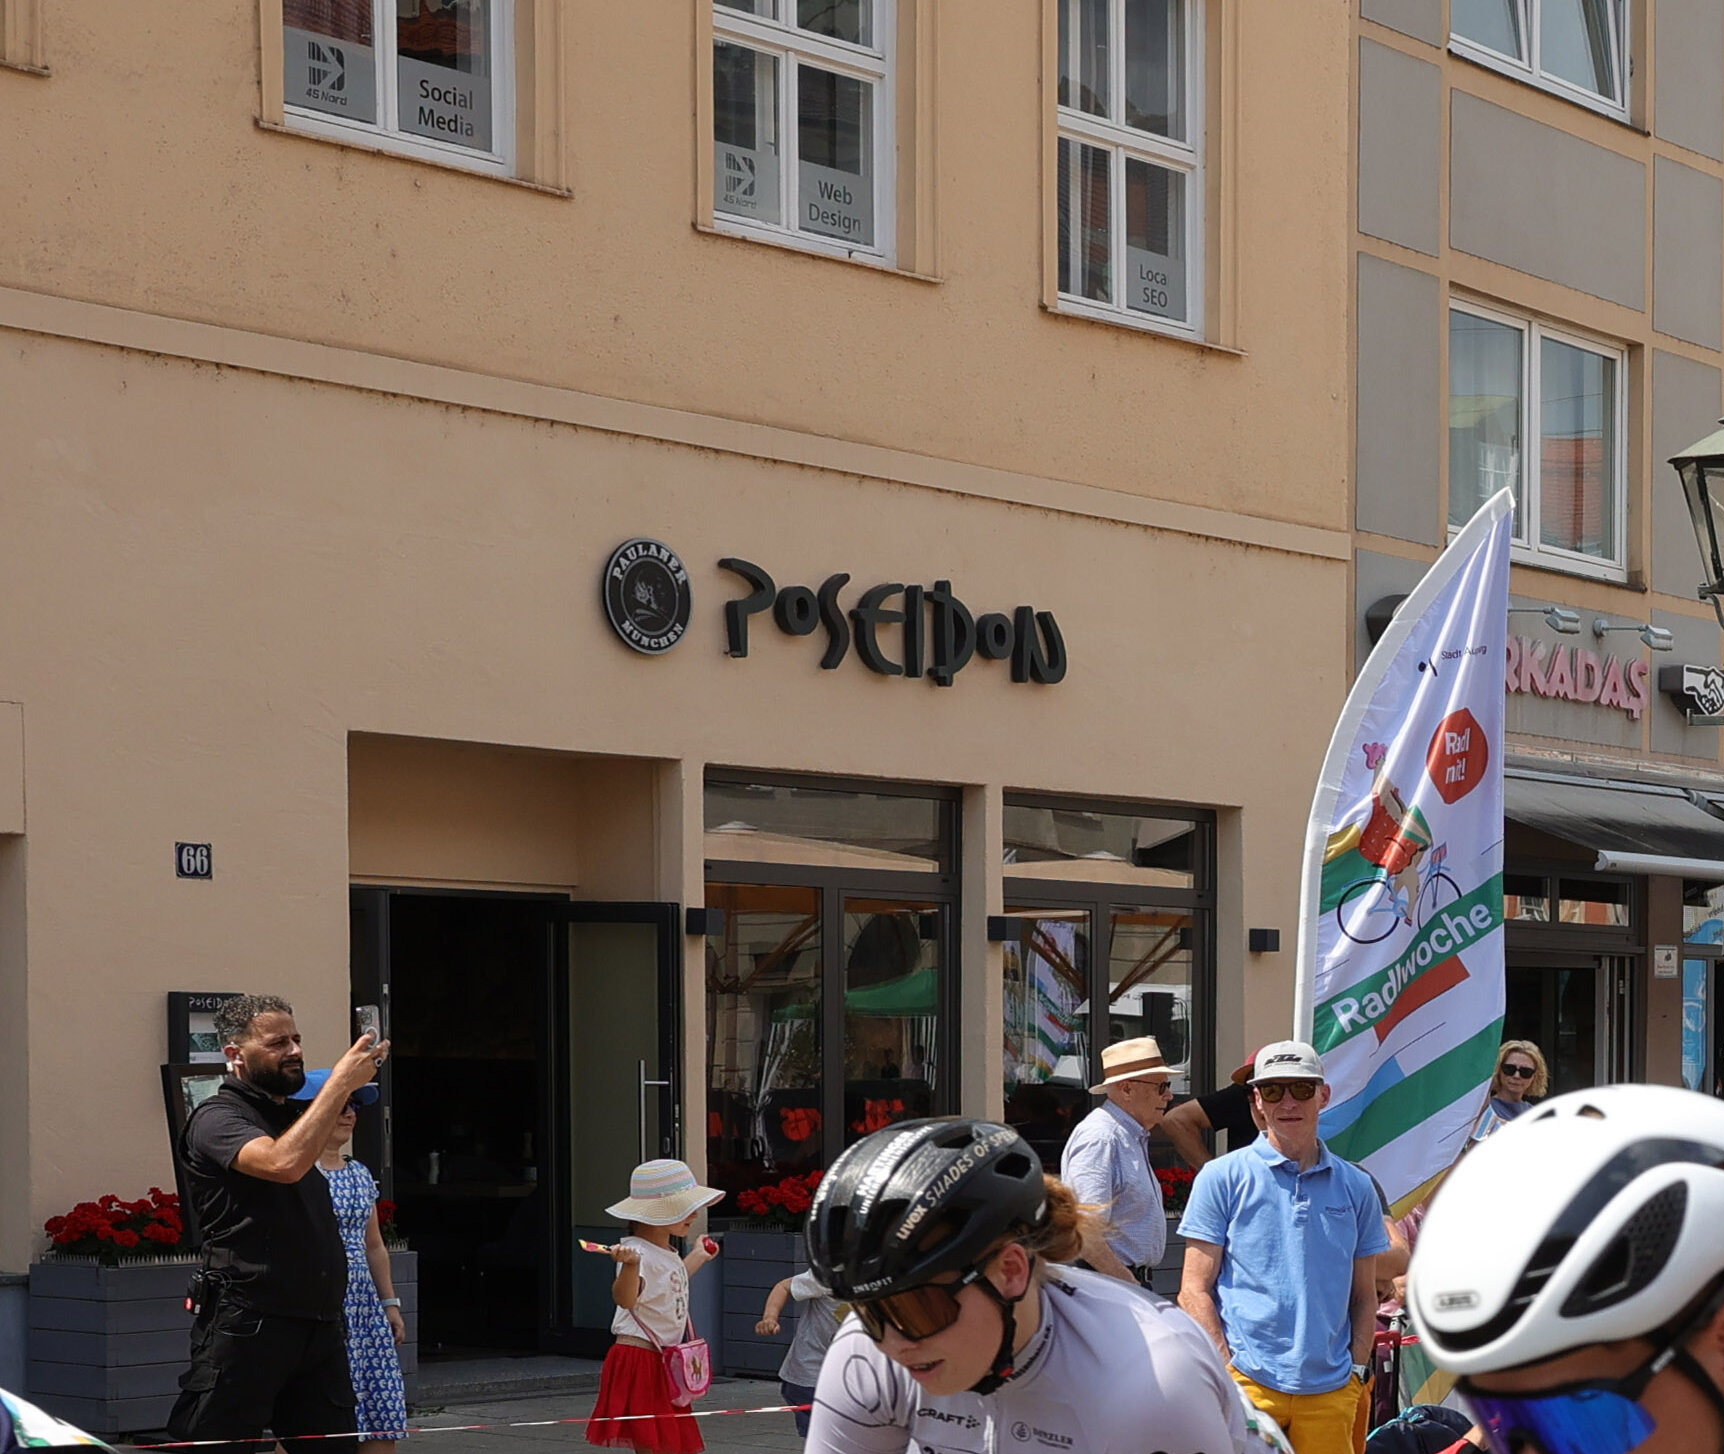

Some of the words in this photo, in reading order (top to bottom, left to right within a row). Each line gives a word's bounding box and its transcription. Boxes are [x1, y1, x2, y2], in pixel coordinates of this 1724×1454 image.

[321, 92, 348, 106] Nord
[418, 79, 474, 110] Social
[418, 106, 475, 137] Media
[818, 179, 854, 206] Web
[808, 202, 862, 235] Design
[1142, 286, 1168, 308] SEO
[612, 544, 687, 585] PAULANER
[1505, 636, 1650, 720] RKADAŞ
[180, 848, 209, 875] 66
[1330, 903, 1494, 1034] Radlwoche
[188, 996, 223, 1009] POSEID
[1263, 1053, 1304, 1066] KTM
[927, 1153, 975, 1208] SHADES
[973, 1140, 991, 1159] OF
[916, 1407, 966, 1428] CRAFT
[1032, 1427, 1074, 1446] DINZLER
